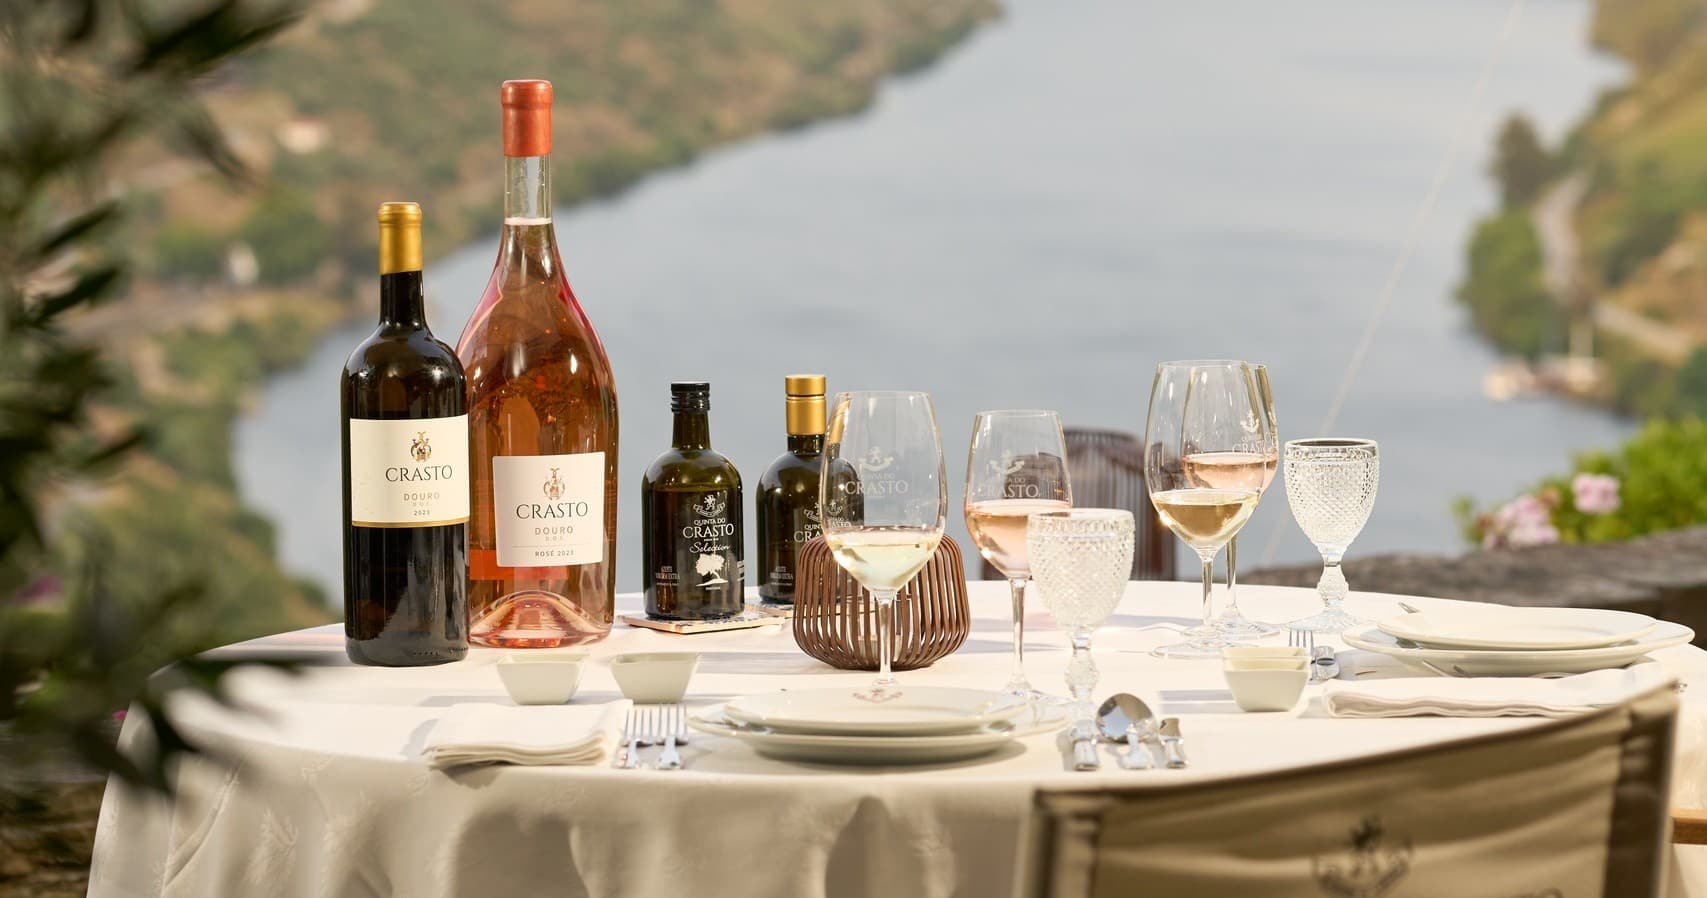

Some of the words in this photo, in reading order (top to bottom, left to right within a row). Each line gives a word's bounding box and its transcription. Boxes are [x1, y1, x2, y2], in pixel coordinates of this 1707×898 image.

[385, 465, 453, 482] CRASTO
[845, 479, 909, 495] CRASTO
[403, 492, 440, 502] DOURO
[516, 501, 589, 520] CRASTO
[693, 519, 716, 527] QUINTA
[804, 523, 821, 531] QUIN
[534, 525, 574, 535] DOURO
[682, 523, 735, 539] CRASTO
[793, 530, 823, 543] CRA
[689, 541, 731, 554] Selection
